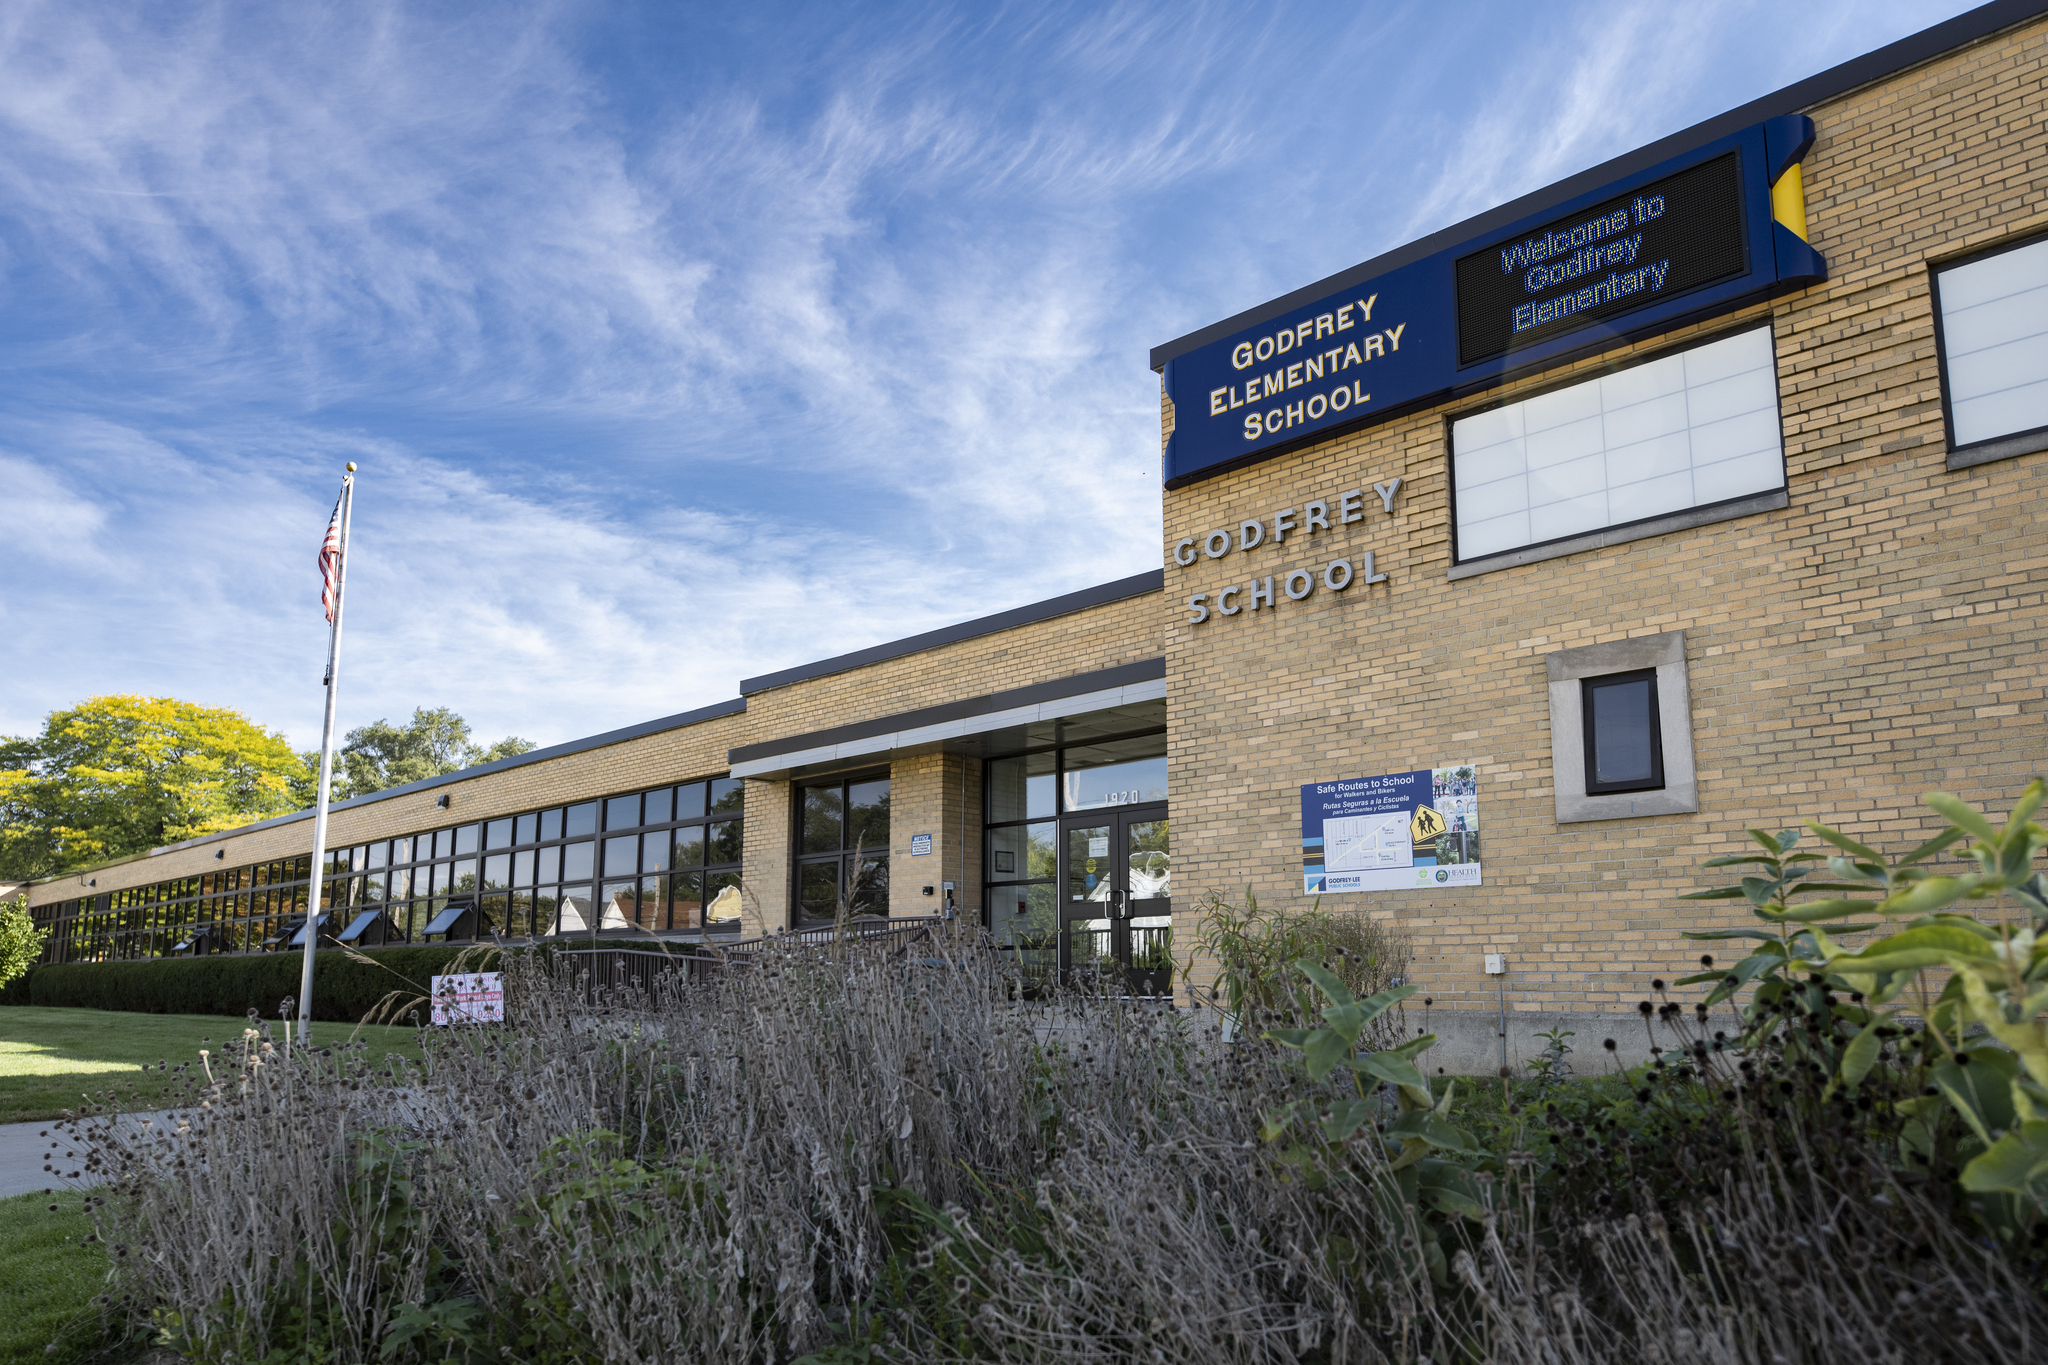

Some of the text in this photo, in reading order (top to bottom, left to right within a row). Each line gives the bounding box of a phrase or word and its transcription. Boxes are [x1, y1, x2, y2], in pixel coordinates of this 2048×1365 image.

[1501, 194, 1666, 275] Welcome to
[1524, 232, 1642, 293] Godfrey
[1512, 258, 1669, 334] Elementary
[1231, 293, 1378, 370] GODFREY
[1209, 322, 1407, 417] ELEMENTARY
[1243, 380, 1371, 441] SCHOOL
[1174, 477, 1403, 567] GODFREY
[1188, 551, 1389, 624] SCHOOL
[1105, 790, 1139, 807] 1920
[1317, 775, 1414, 794] Safe Routes to School
[1322, 802, 1341, 810] Rutas
[1342, 799, 1369, 809] Seguras
[1376, 797, 1382, 805] la
[1383, 794, 1410, 803] Escuela
[1378, 803, 1399, 811] Ciclistas
[1448, 868, 1477, 876] HEALTH
